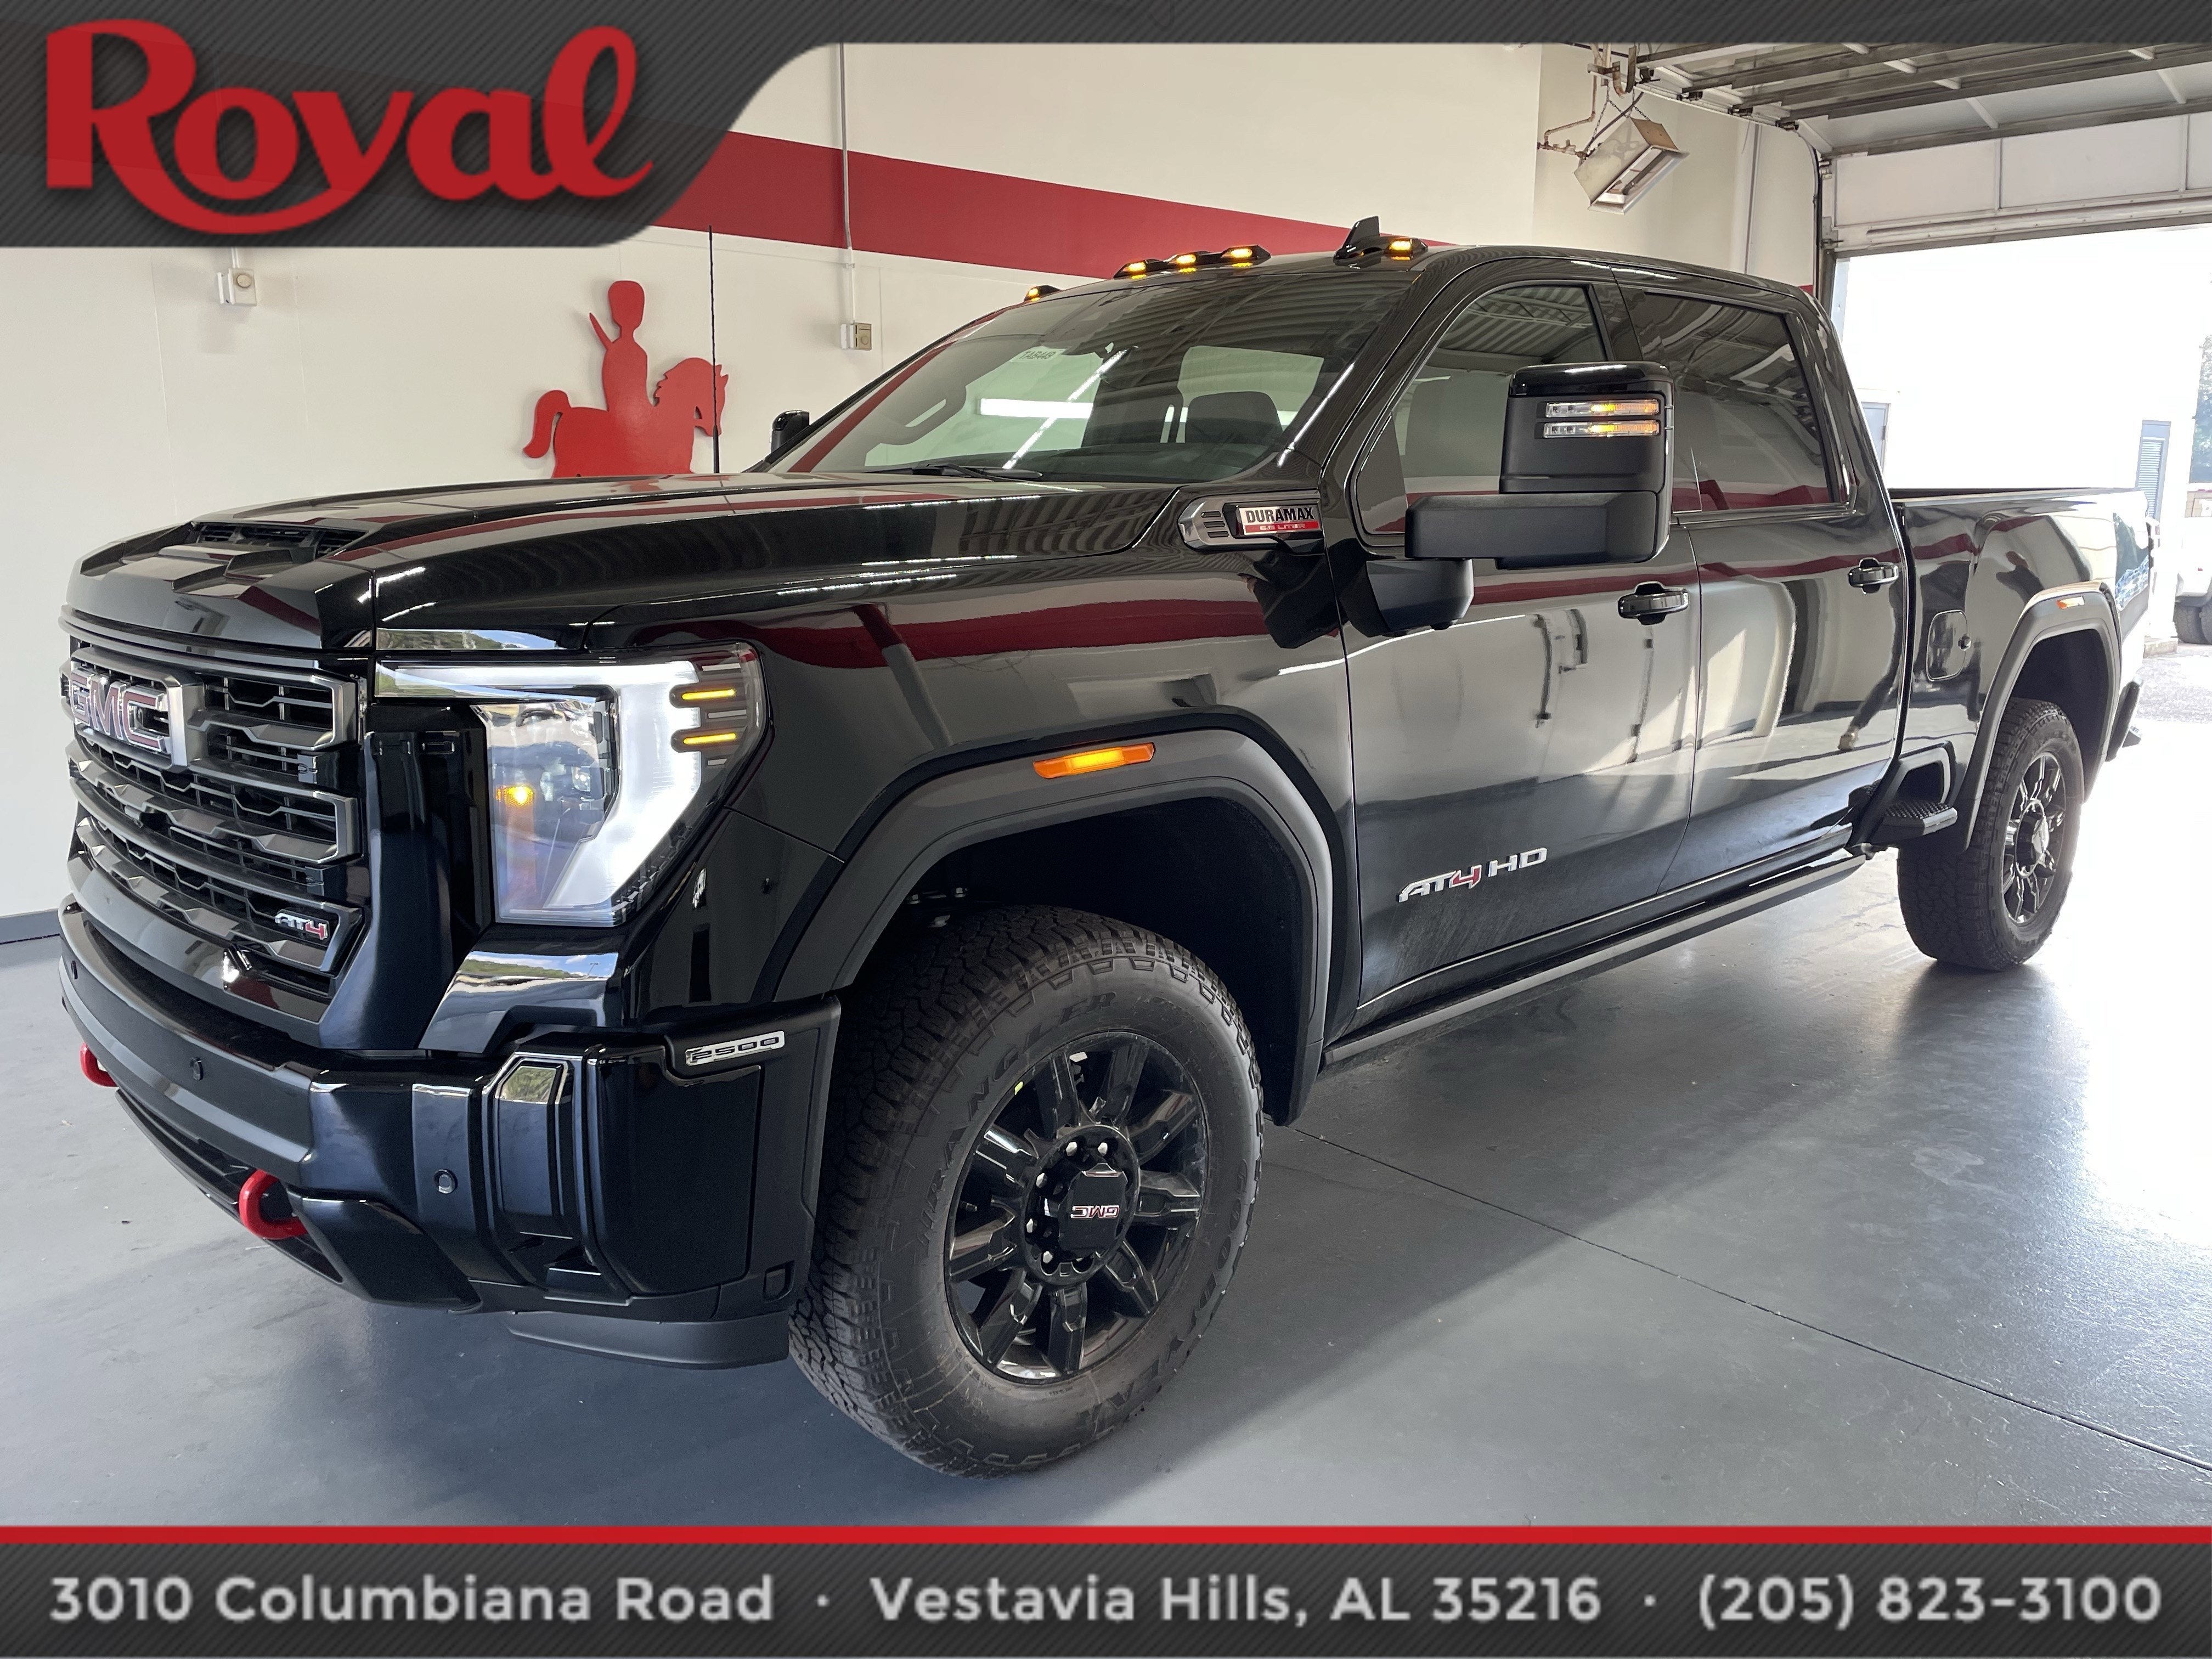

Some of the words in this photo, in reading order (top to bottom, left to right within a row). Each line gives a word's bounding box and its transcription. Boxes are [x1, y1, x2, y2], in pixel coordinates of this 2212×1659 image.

[1245, 507, 1315, 523] DURAMAX
[69, 668, 166, 752] GMC
[1397, 864, 1482, 902] AT4
[1487, 847, 1548, 878] HD
[274, 912, 329, 940] AT4
[688, 1034, 782, 1064] 2500
[1070, 1205, 1120, 1219] GMC
[1077, 1158, 1248, 1430] GOODYEAR
